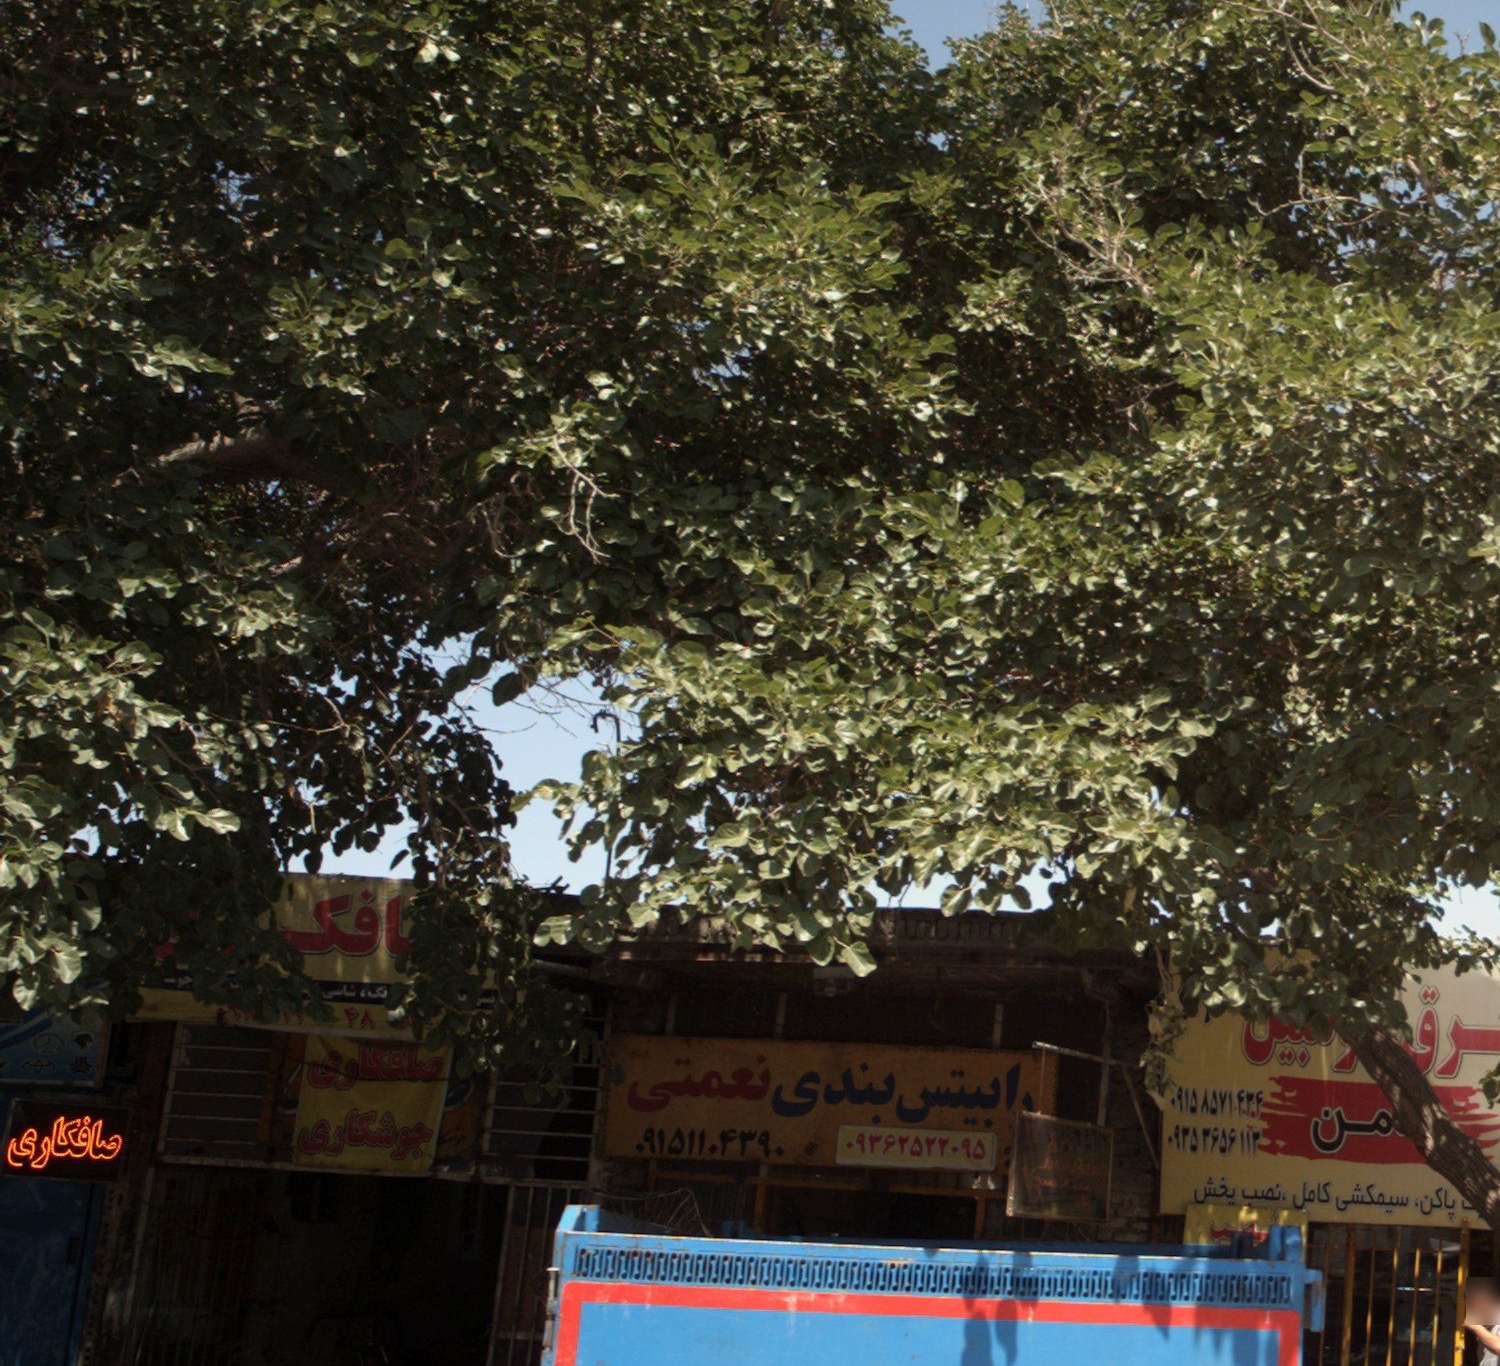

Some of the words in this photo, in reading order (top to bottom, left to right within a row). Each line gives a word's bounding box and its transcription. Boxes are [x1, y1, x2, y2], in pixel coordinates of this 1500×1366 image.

[307, 1042, 444, 1090] صافکاری
[626, 1055, 771, 1112] نعمتی
[770, 1061, 896, 1125] بندی
[6, 1115, 123, 1170] صافکاری
[300, 1109, 433, 1159] جوشکاری
[845, 1133, 987, 1162] ۰۹۳۶۲۵۲۲۰۹۵
[1293, 1180, 1331, 1209] کامل
[1336, 1183, 1409, 1213] سیمکشی
